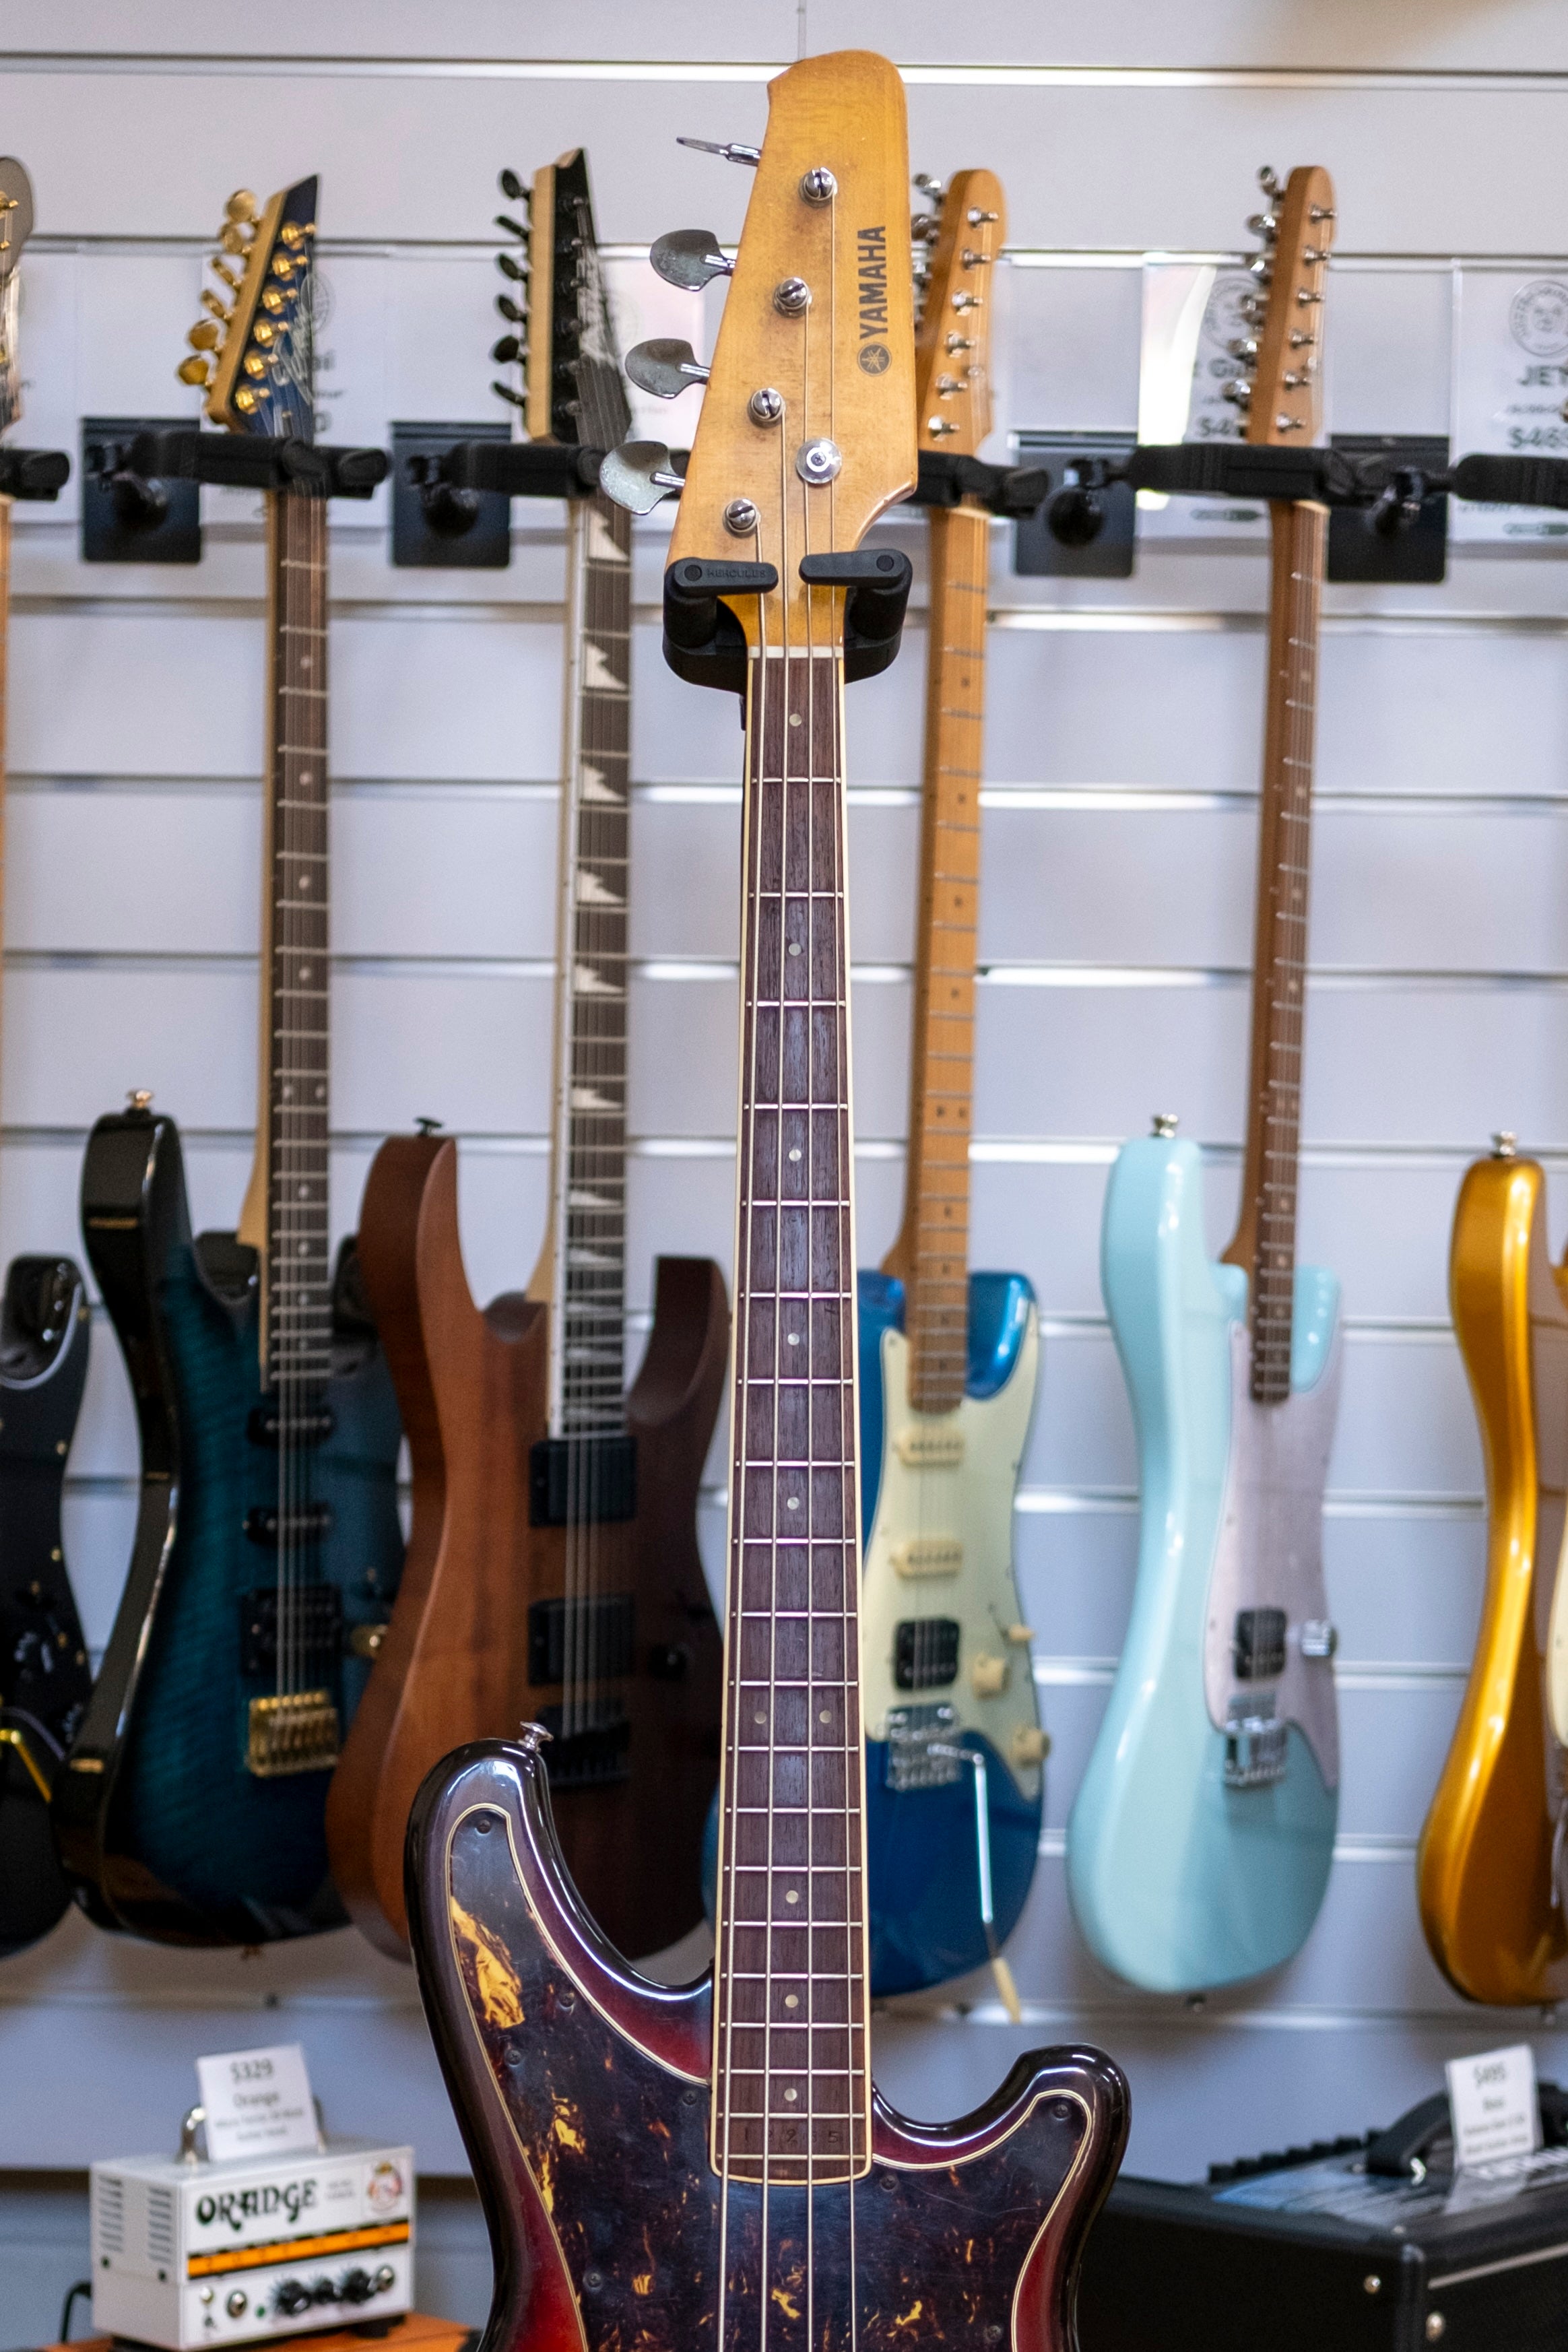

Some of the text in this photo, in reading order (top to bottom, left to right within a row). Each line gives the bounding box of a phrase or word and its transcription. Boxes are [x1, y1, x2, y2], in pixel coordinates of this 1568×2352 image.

[857, 226, 888, 339] YAMAHA
[706, 568, 766, 579] HERCULES
[196, 2178, 318, 2231] ORANGE
